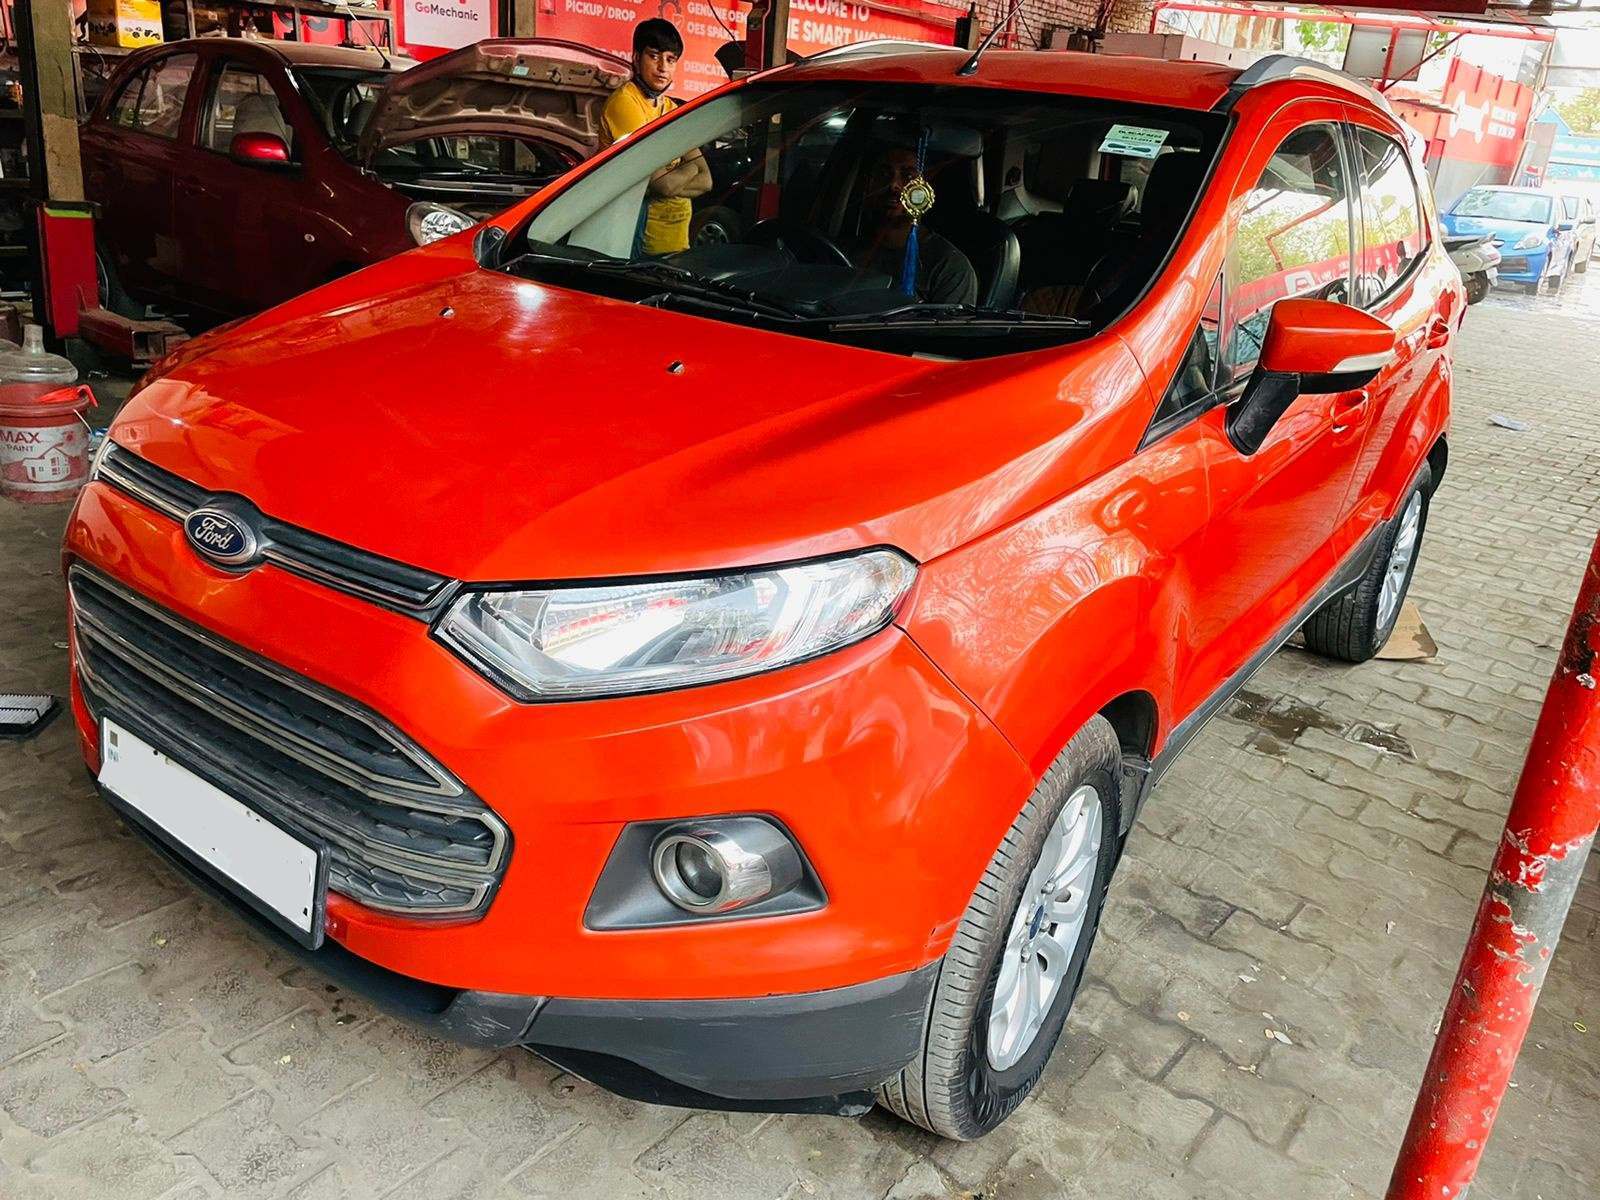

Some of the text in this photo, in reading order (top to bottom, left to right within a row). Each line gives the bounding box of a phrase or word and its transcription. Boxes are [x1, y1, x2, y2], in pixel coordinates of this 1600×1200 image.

[415, 2, 479, 21] GoMechanic
[565, 0, 636, 21] PICKUP/DROP
[803, 20, 851, 46] SMART
[0, 430, 40, 443] MAX
[195, 517, 234, 549] Ford
